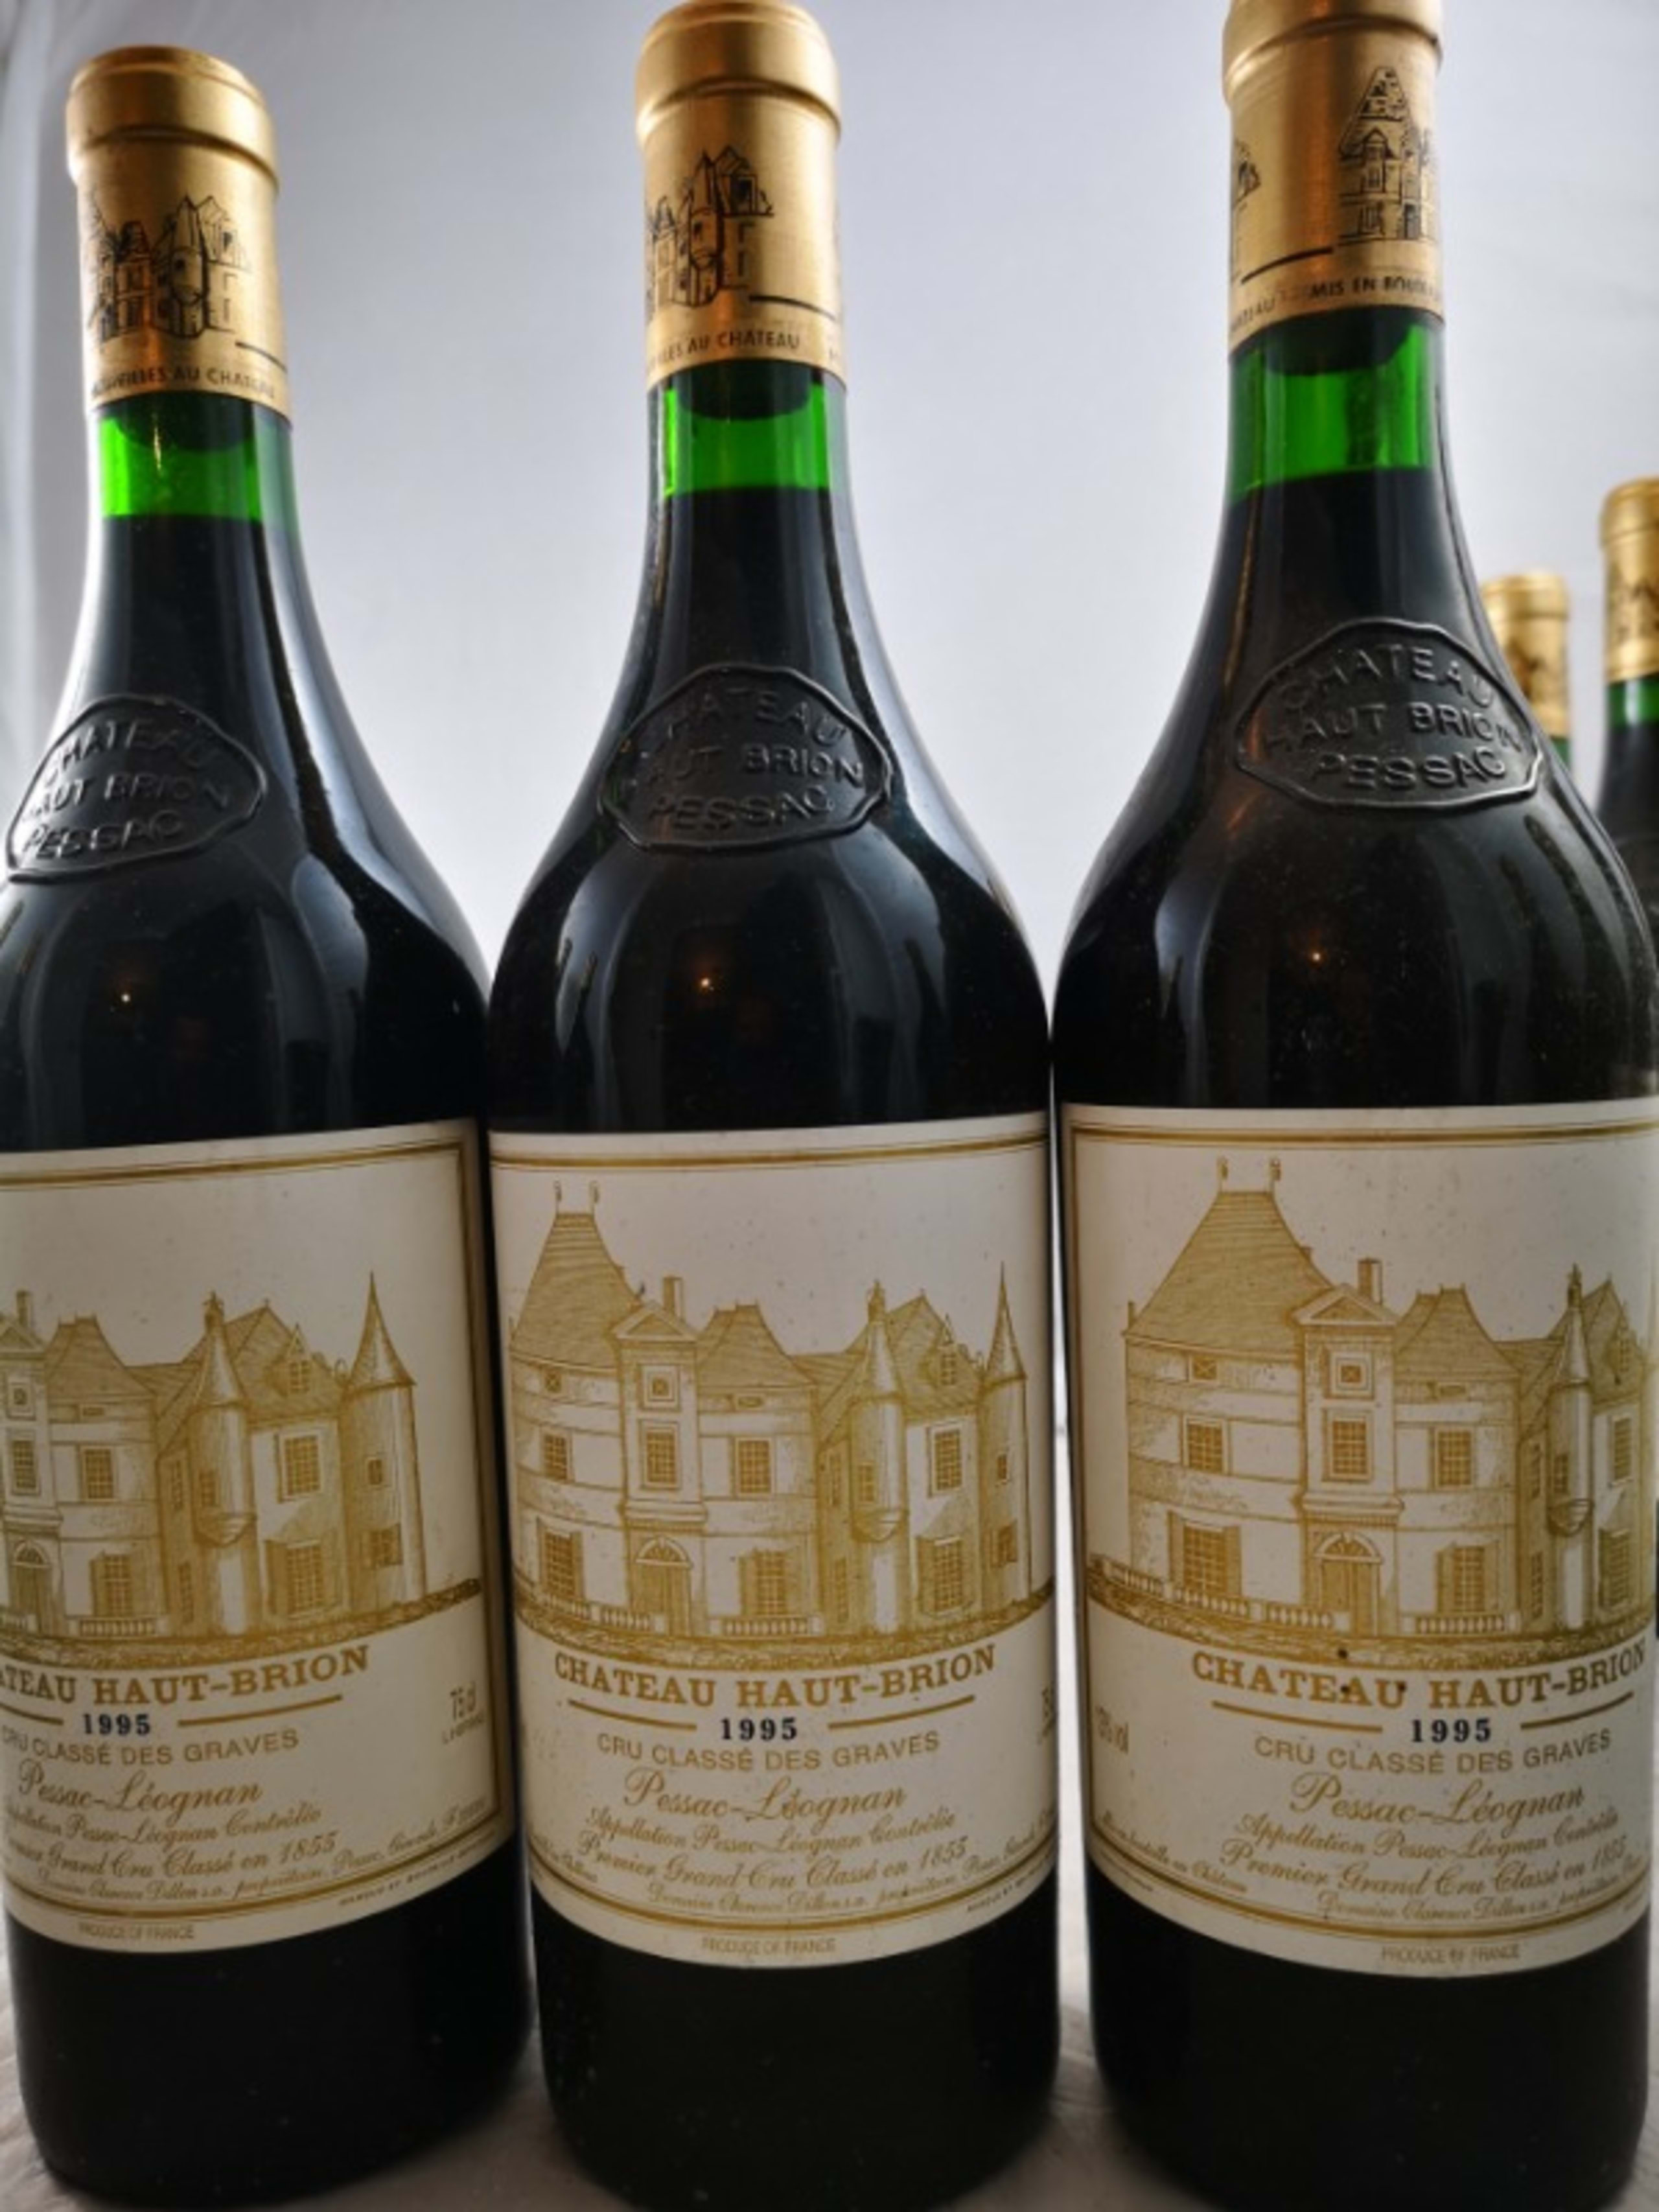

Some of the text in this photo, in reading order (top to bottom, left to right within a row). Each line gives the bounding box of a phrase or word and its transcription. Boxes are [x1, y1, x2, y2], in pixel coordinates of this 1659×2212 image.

[1310, 280, 1345, 299] MIS
[1353, 276, 1376, 292] EN
[688, 335, 710, 356] AU
[717, 329, 800, 349] CHATEAU
[1409, 701, 1522, 754] BRION
[741, 743, 863, 787] BRION
[1308, 745, 1507, 791] PESSAC
[648, 784, 835, 831] PESSAC
[93, 1644, 369, 1705] HAUT-BRION
[555, 1644, 996, 1708] CHATEAU HAUT-BRION
[1192, 1638, 1646, 1709] CHATEAU HAUT-BRION
[32, 1738, 112, 1765] CLASSÉ
[121, 1745, 172, 1765] DES
[184, 1728, 299, 1763] GRAVES
[83, 1712, 152, 1736] 1995
[719, 1717, 799, 1741] 1995
[1410, 1717, 1492, 1743] 1995
[597, 1730, 940, 1772] CRU CLASSÉ DES GRAVES
[1254, 1728, 1612, 1775] CRU CLASSÉ DES GRAVES
[18, 1758, 262, 1828] Pessac-Léognan
[623, 1765, 907, 1836] Pessac-Léognan
[1289, 1771, 1585, 1839] Pessac-Léognan
[585, 1806, 687, 1847] Appellation
[1234, 1812, 1365, 1851] Appellation
[1373, 1828, 1548, 1867] Pessac-Léognan
[47, 1842, 109, 1876] Grand
[111, 1849, 154, 1878] Cru
[240, 1853, 268, 1870] en
[278, 1830, 340, 1865] 1855
[576, 1830, 658, 1876] Premier
[661, 1852, 743, 1887] Grand
[747, 1860, 795, 1889] Cru
[882, 1862, 908, 1880] en
[920, 1835, 969, 1870] 1855
[1219, 1837, 1329, 1885] Premier
[1336, 1859, 1433, 1896] Grand
[1435, 1865, 1485, 1898] Cru
[1494, 1859, 1561, 1896] Classé
[1564, 1862, 1584, 1881] en
